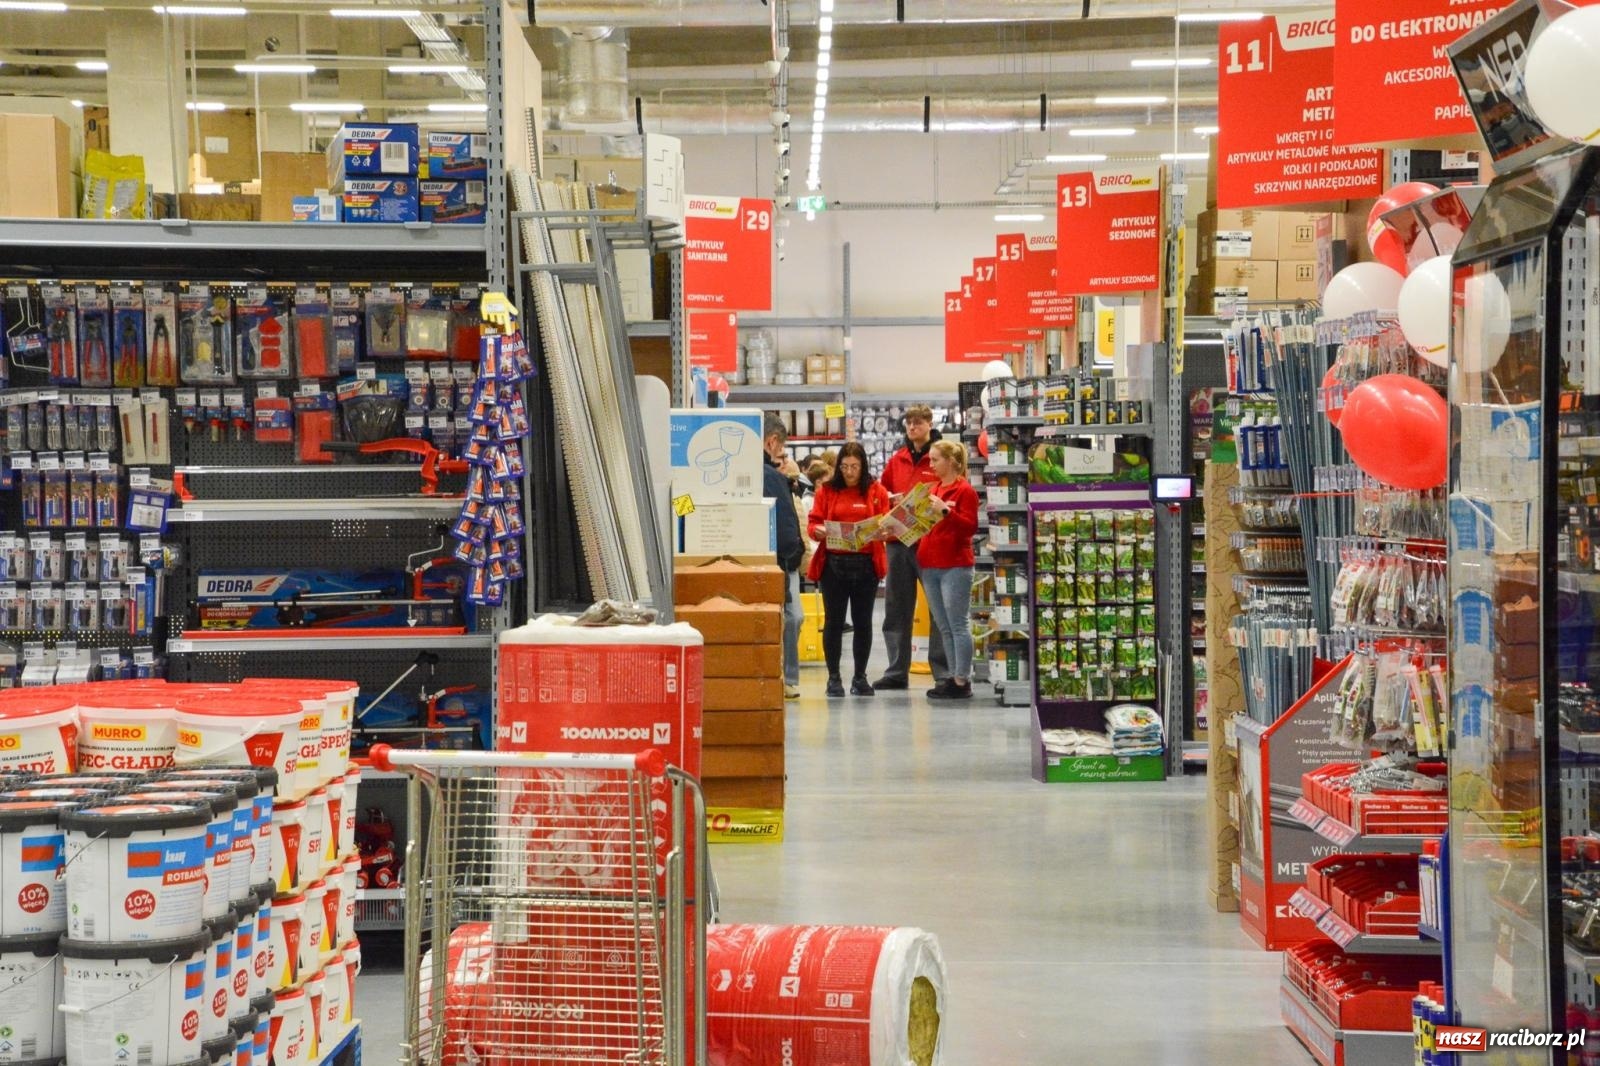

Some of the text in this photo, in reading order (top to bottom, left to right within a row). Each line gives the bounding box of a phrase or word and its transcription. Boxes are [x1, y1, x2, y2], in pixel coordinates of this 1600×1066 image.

[1350, 25, 1375, 44] DO
[1226, 39, 1264, 74] 11
[351, 130, 376, 139] DEDRA
[431, 135, 453, 143] DEDRA
[1276, 131, 1318, 146] WKRĘTY
[1227, 150, 1274, 166] ARTYKUŁY
[1276, 145, 1329, 161] METALOWE
[1331, 144, 1347, 155] NA
[1283, 162, 1312, 176] KOŁKI
[1319, 157, 1378, 172] PODKŁADKI
[351, 182, 376, 191] DEDRA
[422, 183, 443, 191] DEDRA
[1099, 174, 1132, 187] BRICO
[1254, 173, 1377, 194] SKRZYNKI NARZĘDZIOWE
[1061, 185, 1088, 208] 13
[688, 200, 717, 211] BRICO
[746, 210, 770, 231] 29
[1111, 216, 1156, 228] ARTYKUŁY
[1030, 235, 1055, 245] BRICO
[1109, 229, 1156, 241] SEZONOWE
[686, 251, 728, 262] SANITARNE
[1000, 243, 1021, 261] 15
[976, 266, 994, 282] 17
[1089, 274, 1156, 286] ARTYKUŁY SEZONOWE
[963, 284, 972, 298] 1
[947, 299, 961, 312] 21
[206, 580, 252, 593] DEDRA
[94, 727, 142, 739] MURRO
[560, 727, 650, 740] ROCKWOOL
[253, 747, 264, 757] 17
[165, 849, 186, 865] knauf
[1277, 862, 1310, 876] MET
[20, 887, 46, 901] 10%
[126, 892, 153, 907] 10%
[22, 898, 47, 910] więcej
[128, 904, 153, 916] więcej
[502, 999, 584, 1019] ROCKROLL
[183, 1013, 199, 1029] 10%
